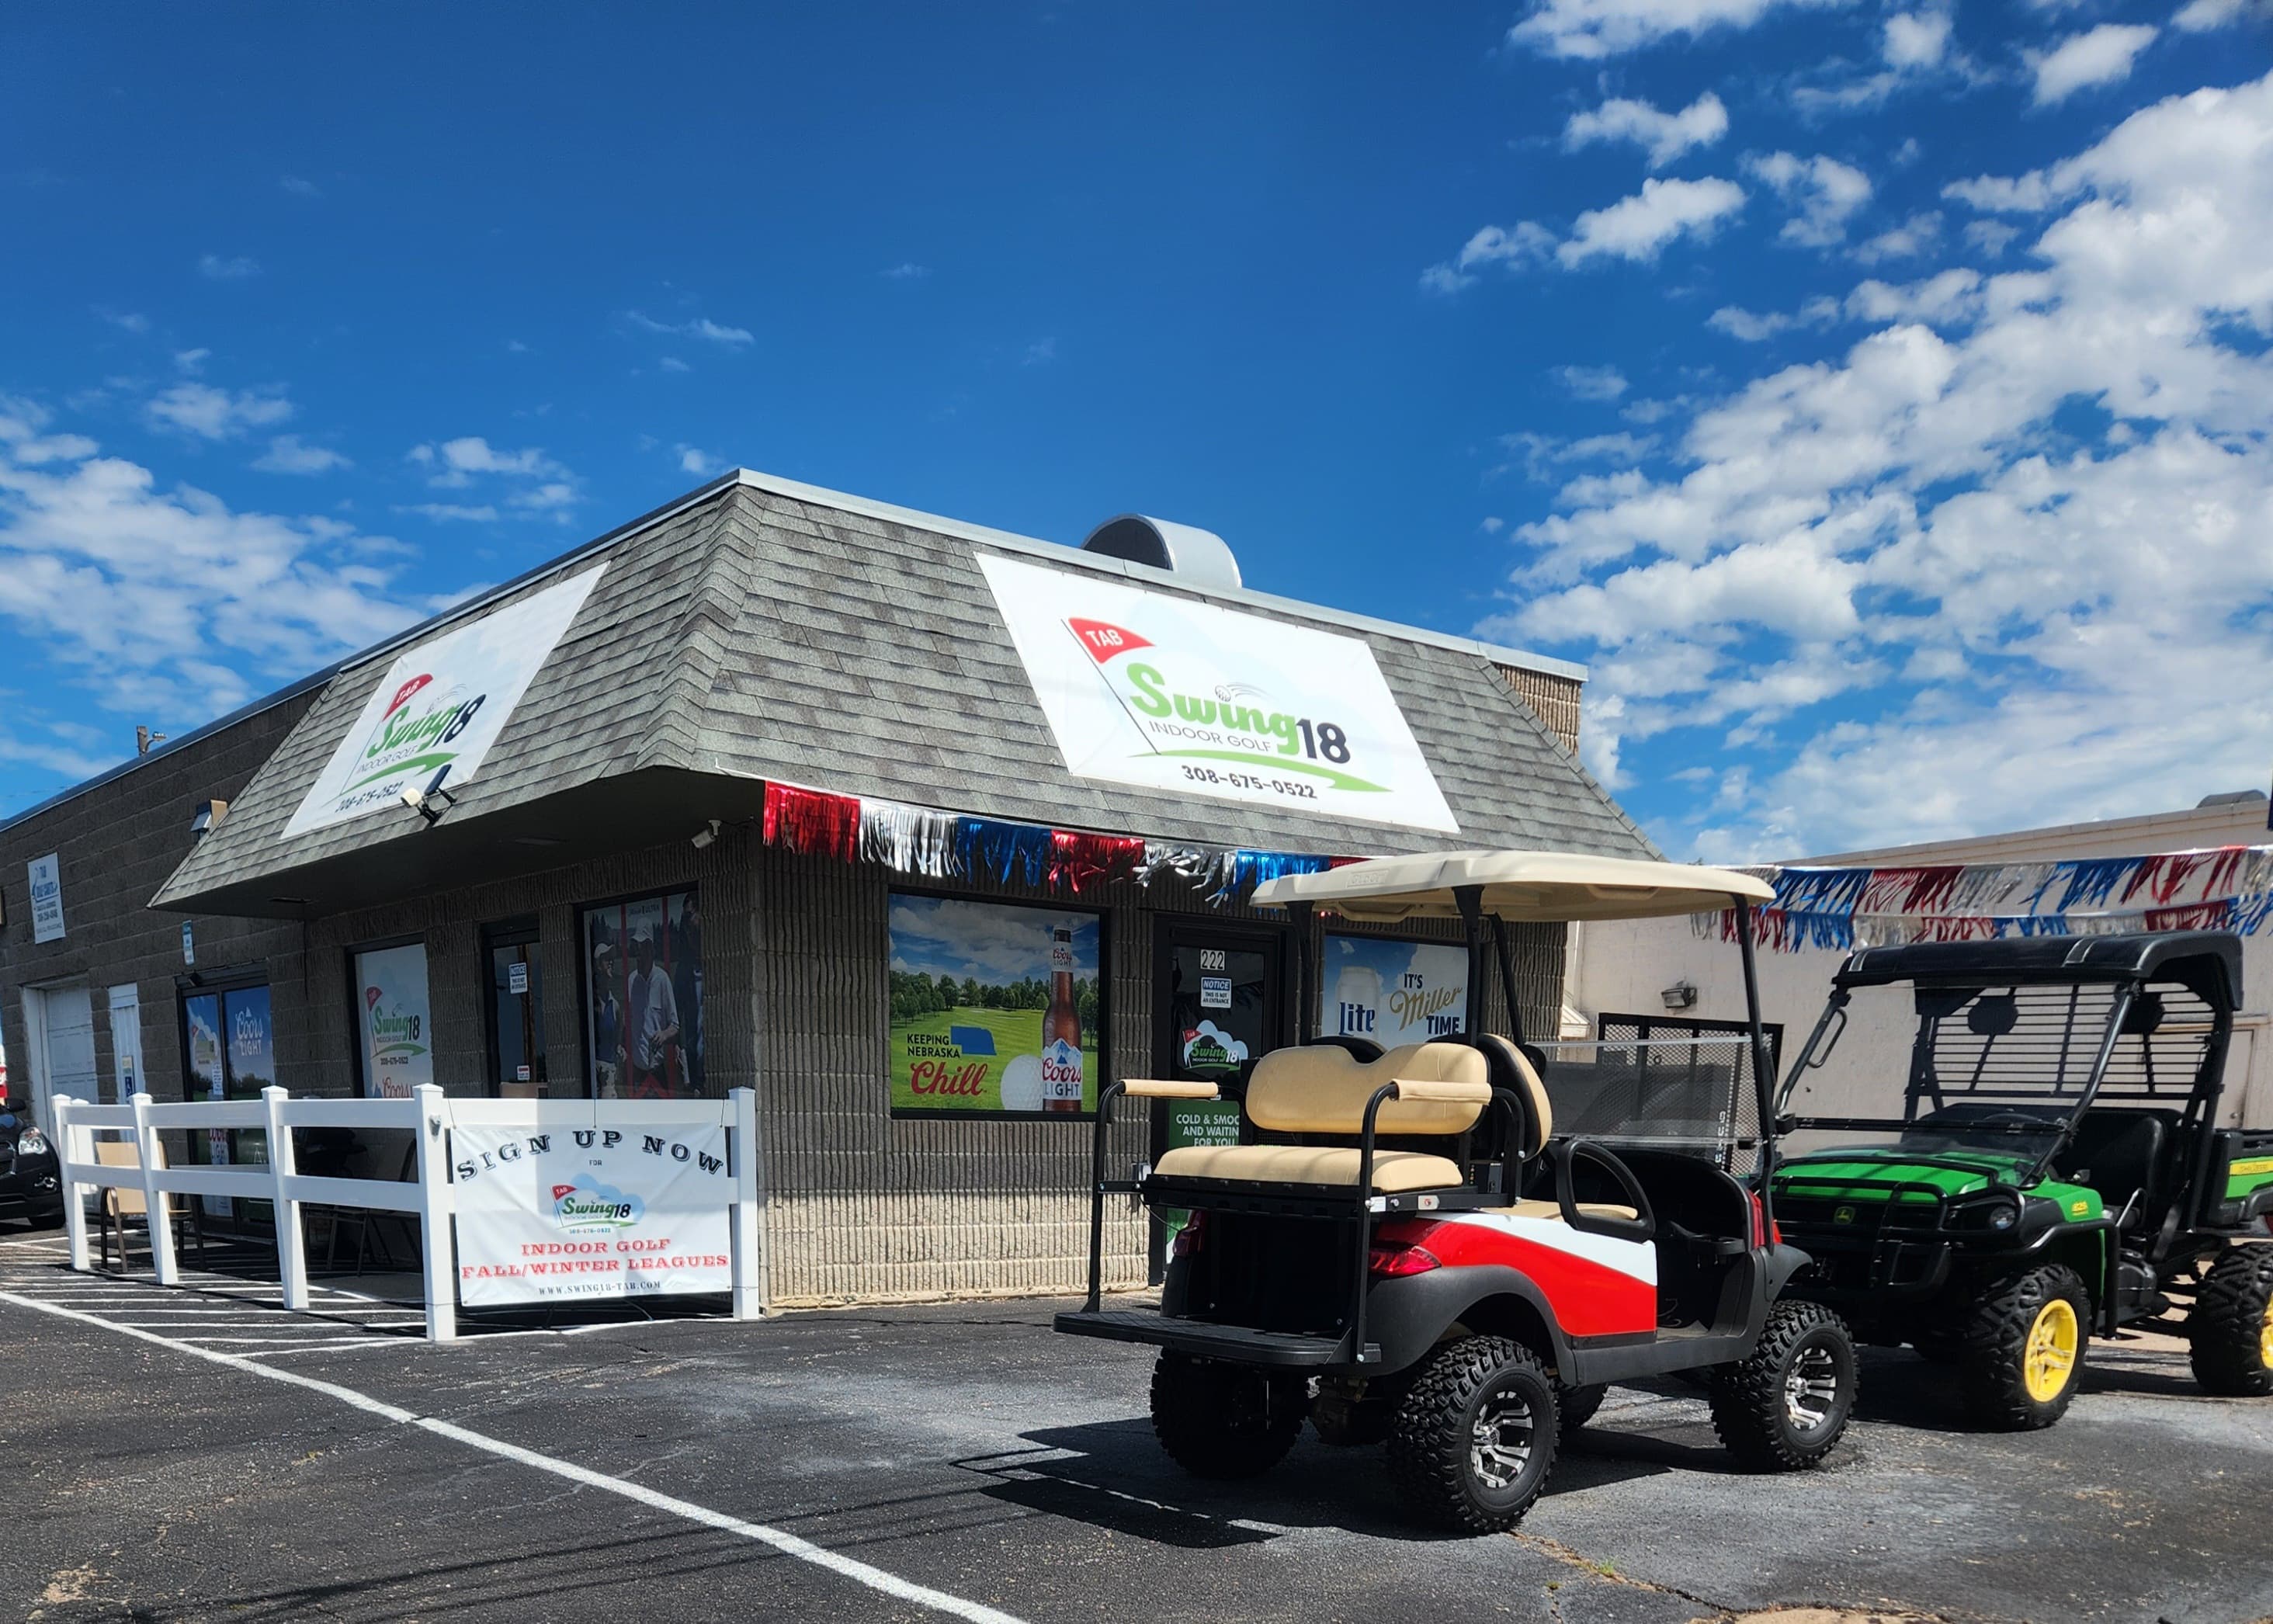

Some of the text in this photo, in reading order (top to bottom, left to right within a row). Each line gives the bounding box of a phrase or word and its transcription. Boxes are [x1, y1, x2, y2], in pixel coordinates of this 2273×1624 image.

[1085, 628, 1124, 648] TAB
[396, 680, 420, 703] TAB
[1149, 720, 1272, 752] INDOOR GOLF
[1181, 765, 1318, 800] 308-675-0522
[1053, 959, 1072, 967] LIGHT
[1201, 950, 1224, 970] 222
[1203, 980, 1229, 990] NOTICE
[1404, 973, 1423, 989] IT'S
[1390, 986, 1463, 1031] Miller
[235, 1010, 264, 1039] Coors
[1338, 1001, 1376, 1036] Lite
[1426, 1015, 1460, 1034] TIME
[239, 1039, 262, 1057] LIGHT
[907, 1033, 949, 1046] KEEPING
[907, 1047, 960, 1058] NEBRASKA
[910, 1060, 988, 1096] Chill
[1042, 1057, 1082, 1081] Coors
[1044, 1084, 1080, 1097] LIGHT
[1176, 1114, 1201, 1124] COLD
[1203, 1114, 1210, 1124] &
[1182, 1126, 1204, 1136] AND
[1194, 1138, 1235, 1147] FOR YOU
[456, 1130, 724, 1181] SIGN UP NOW
[521, 1238, 671, 1256] INDOOR GOLF
[461, 1254, 729, 1279] FALL/WINTER LEAGUES
